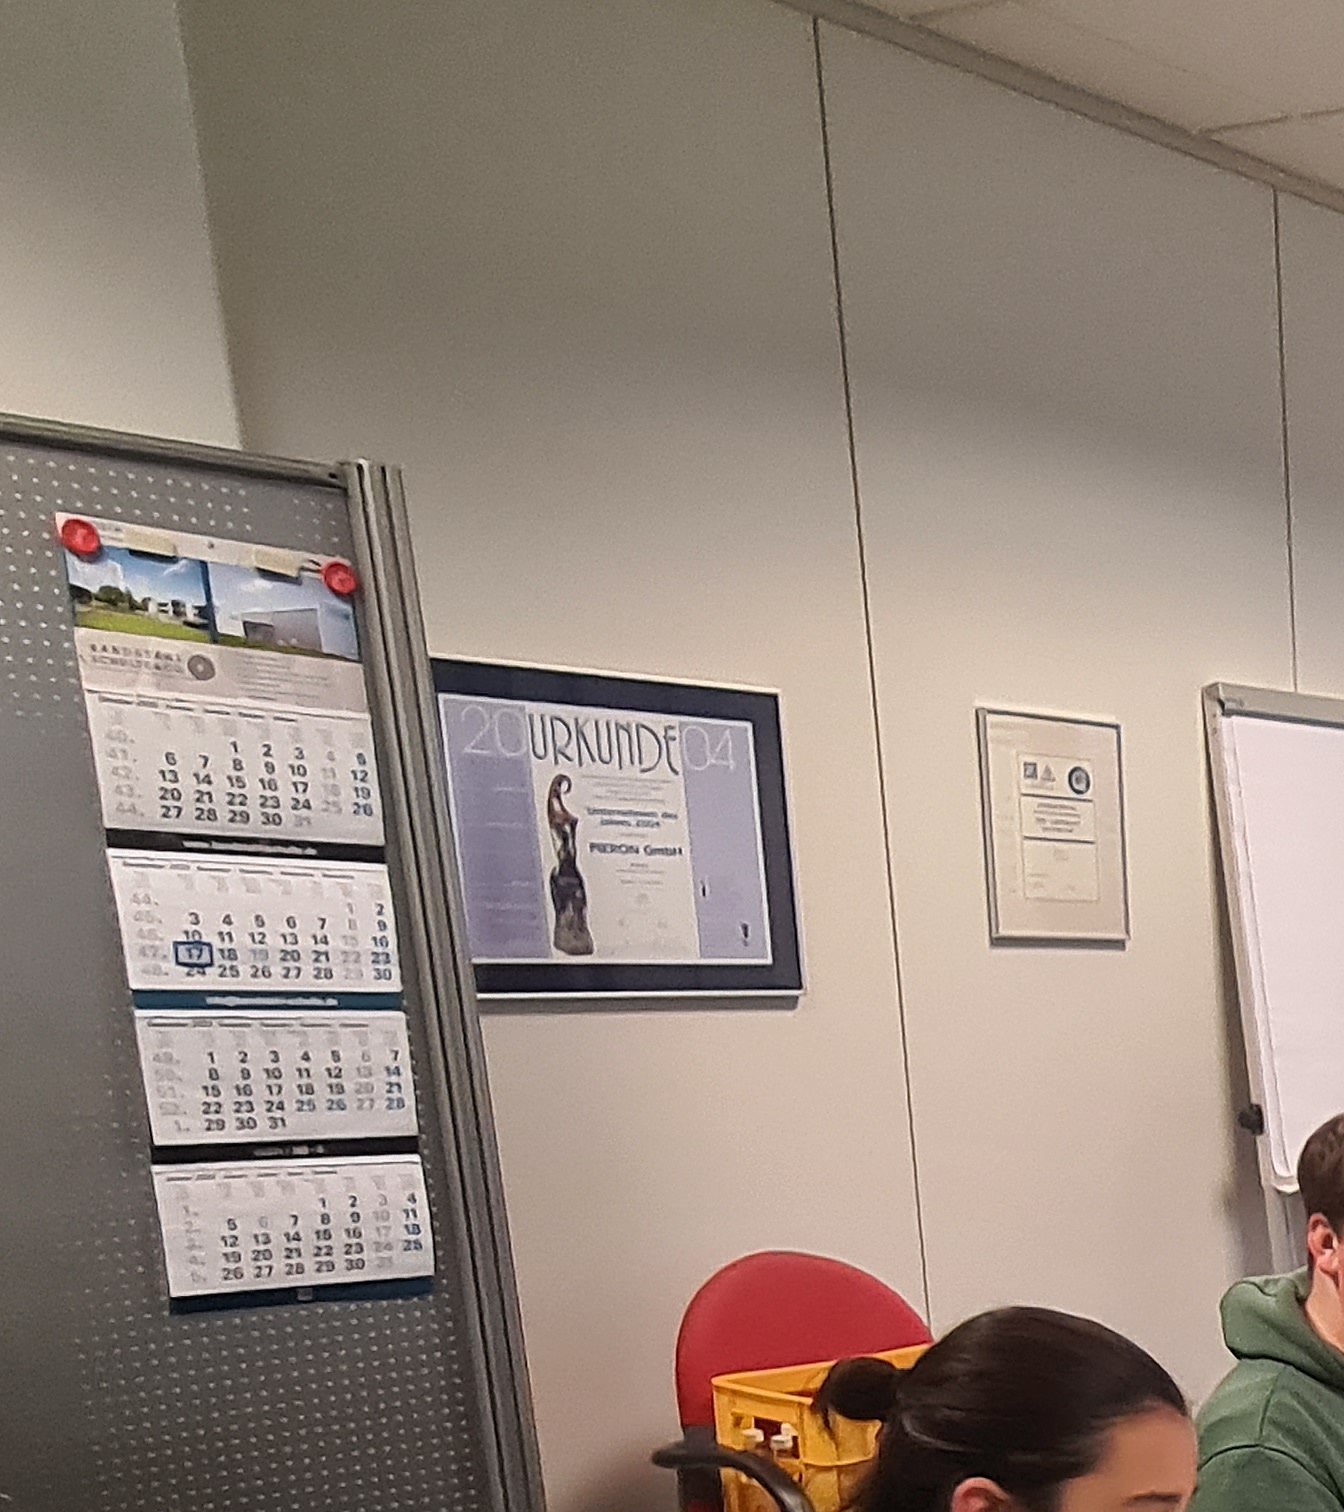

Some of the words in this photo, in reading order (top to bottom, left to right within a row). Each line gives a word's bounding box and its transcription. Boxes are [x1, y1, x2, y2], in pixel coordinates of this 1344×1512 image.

[460, 705, 527, 757] 20
[528, 712, 680, 776] URKUNDE
[683, 726, 735, 771] 04
[230, 741, 238, 753] 1
[262, 744, 273, 757] 2
[295, 747, 304, 760] 3
[165, 752, 176, 766] 6
[199, 755, 209, 768] 7
[264, 761, 275, 775] 9
[289, 764, 307, 777] 10
[351, 770, 368, 783] 12
[159, 770, 179, 783] 13
[193, 773, 213, 786] 14
[227, 775, 246, 789] 15
[292, 781, 308, 794] 17
[159, 787, 182, 802] 20
[195, 790, 213, 803] 21
[226, 792, 248, 806] 22
[259, 795, 280, 809] 23
[291, 797, 312, 810] 24
[161, 805, 182, 818] 27
[195, 807, 217, 822] 28
[228, 810, 250, 824] 29
[261, 812, 282, 826] 30
[376, 904, 384, 916] 2
[189, 912, 200, 925] 3
[222, 914, 233, 926] 4
[286, 916, 296, 929] 6
[318, 918, 326, 930] 7
[377, 920, 387, 931] 9
[217, 931, 233, 943] 11
[249, 932, 267, 944] 12
[280, 933, 298, 945] 13
[312, 934, 329, 945] 14
[372, 936, 389, 948] 16
[280, 949, 301, 962] 20
[312, 950, 330, 963] 21
[218, 964, 240, 978] 25
[251, 965, 272, 978] 26
[283, 966, 301, 979] 27
[373, 968, 392, 980] 30
[208, 1052, 214, 1064] 1
[239, 1051, 248, 1063] 2
[270, 1050, 280, 1063] 3
[301, 1051, 311, 1062] 4
[391, 1050, 399, 1061] 7
[240, 1068, 251, 1080] 9
[263, 1067, 282, 1080] 10
[296, 1066, 311, 1080] 11
[325, 1066, 342, 1079] 12
[202, 1085, 221, 1097] 15
[235, 1084, 253, 1096] 16
[266, 1084, 282, 1096] 17
[297, 1083, 315, 1095] 18
[386, 1082, 402, 1093] 21
[202, 1101, 222, 1115] 22
[234, 1100, 254, 1113] 23
[264, 1100, 285, 1112] 24
[326, 1099, 347, 1111] 26
[205, 1119, 225, 1131] 29
[236, 1117, 257, 1130] 30
[268, 1116, 286, 1129] 31
[319, 1198, 326, 1209] 1
[349, 1196, 357, 1208] 2
[290, 1215, 298, 1226] 7
[321, 1213, 330, 1225] 8
[350, 1212, 360, 1223] 9
[402, 1208, 417, 1221] 11
[221, 1235, 239, 1247] 12
[253, 1233, 271, 1245] 13
[284, 1231, 302, 1243] 14
[344, 1227, 362, 1239] 16
[222, 1251, 241, 1263] 19
[251, 1249, 273, 1262] 20
[284, 1247, 302, 1259] 21
[313, 1245, 333, 1257] 22
[344, 1242, 364, 1255] 23
[222, 1267, 244, 1280] 26
[254, 1265, 273, 1278] 27
[315, 1260, 335, 1273] 29
[345, 1258, 365, 1271] 30
